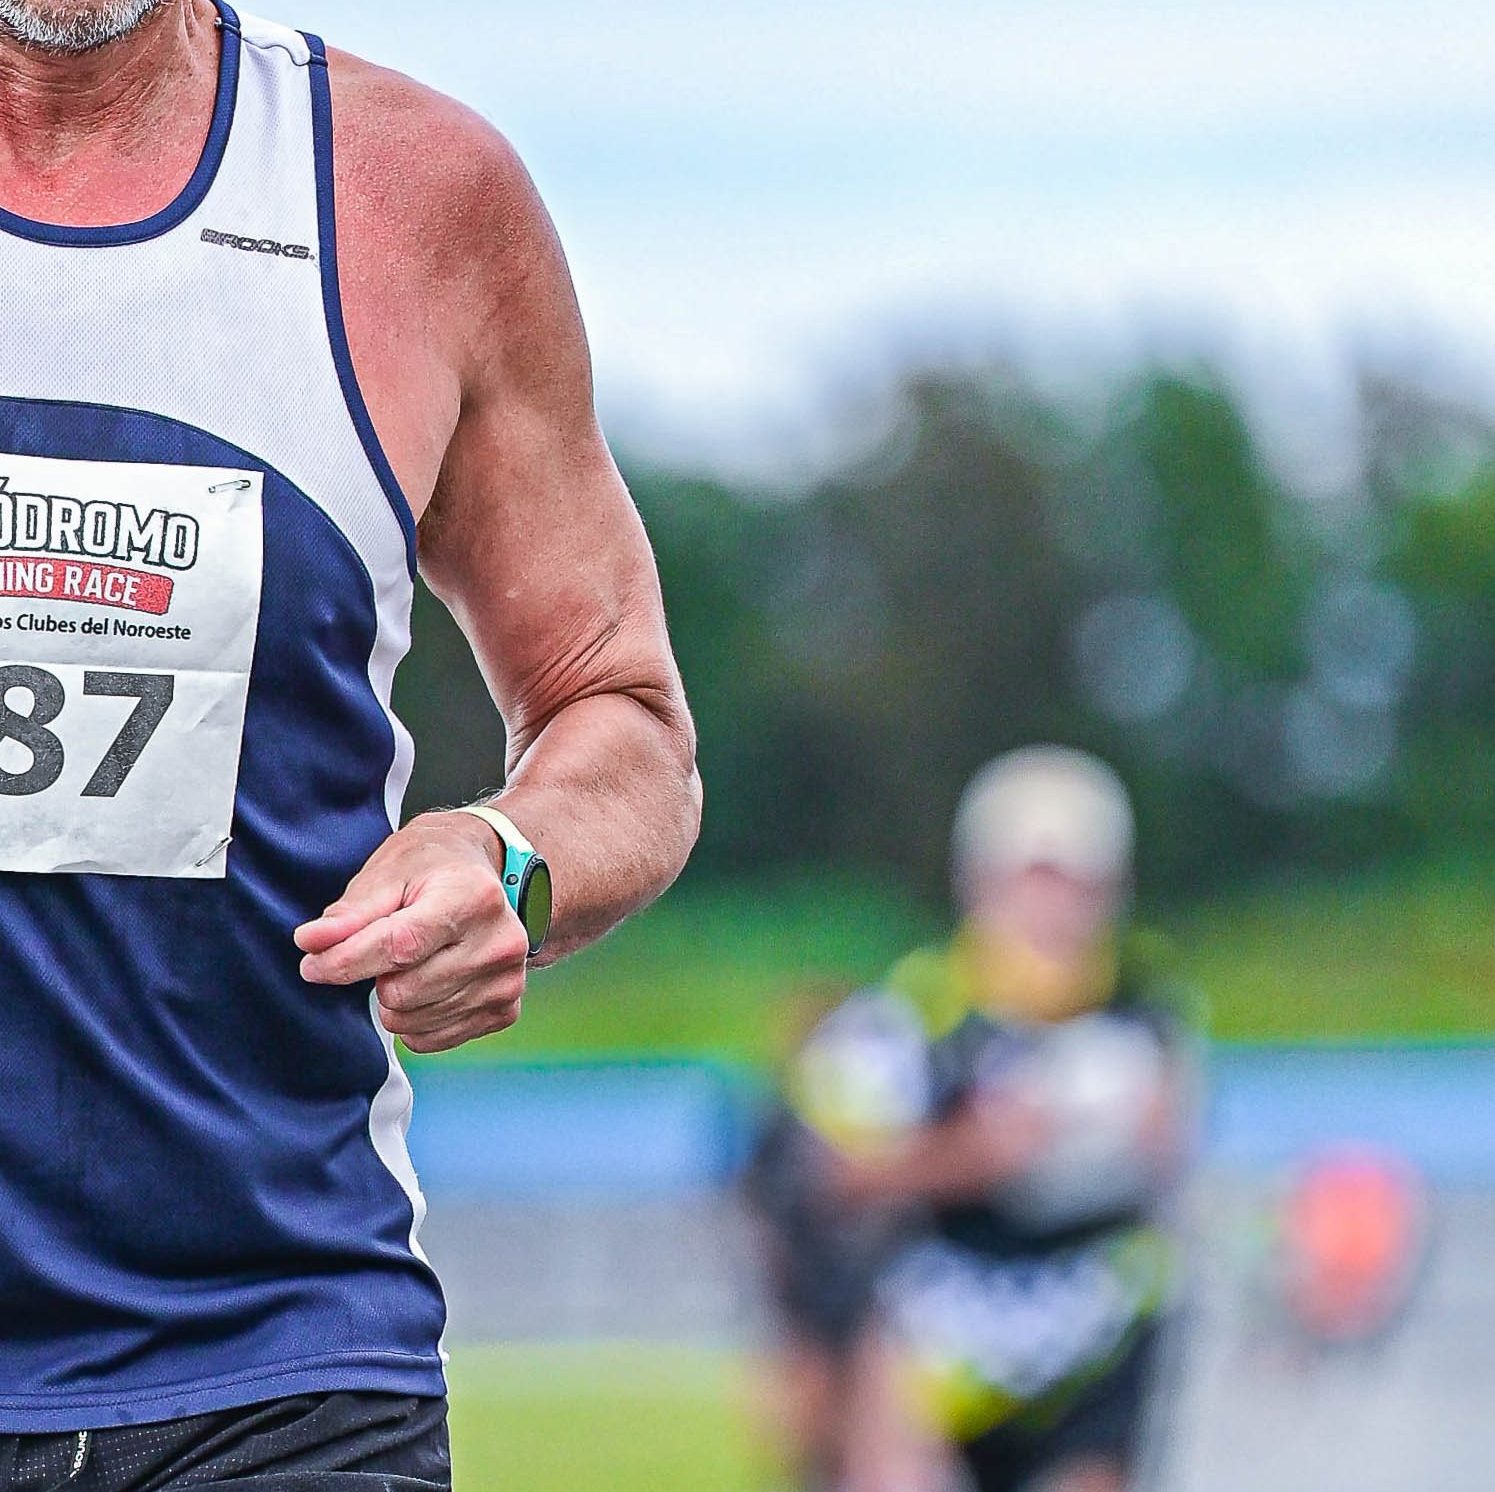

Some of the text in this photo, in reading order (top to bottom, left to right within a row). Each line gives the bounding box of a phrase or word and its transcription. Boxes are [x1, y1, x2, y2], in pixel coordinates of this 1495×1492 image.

[63, 566, 143, 606] RACE
[16, 613, 77, 633] Clubes
[81, 616, 109, 636] del
[113, 619, 192, 640] Noroeste
